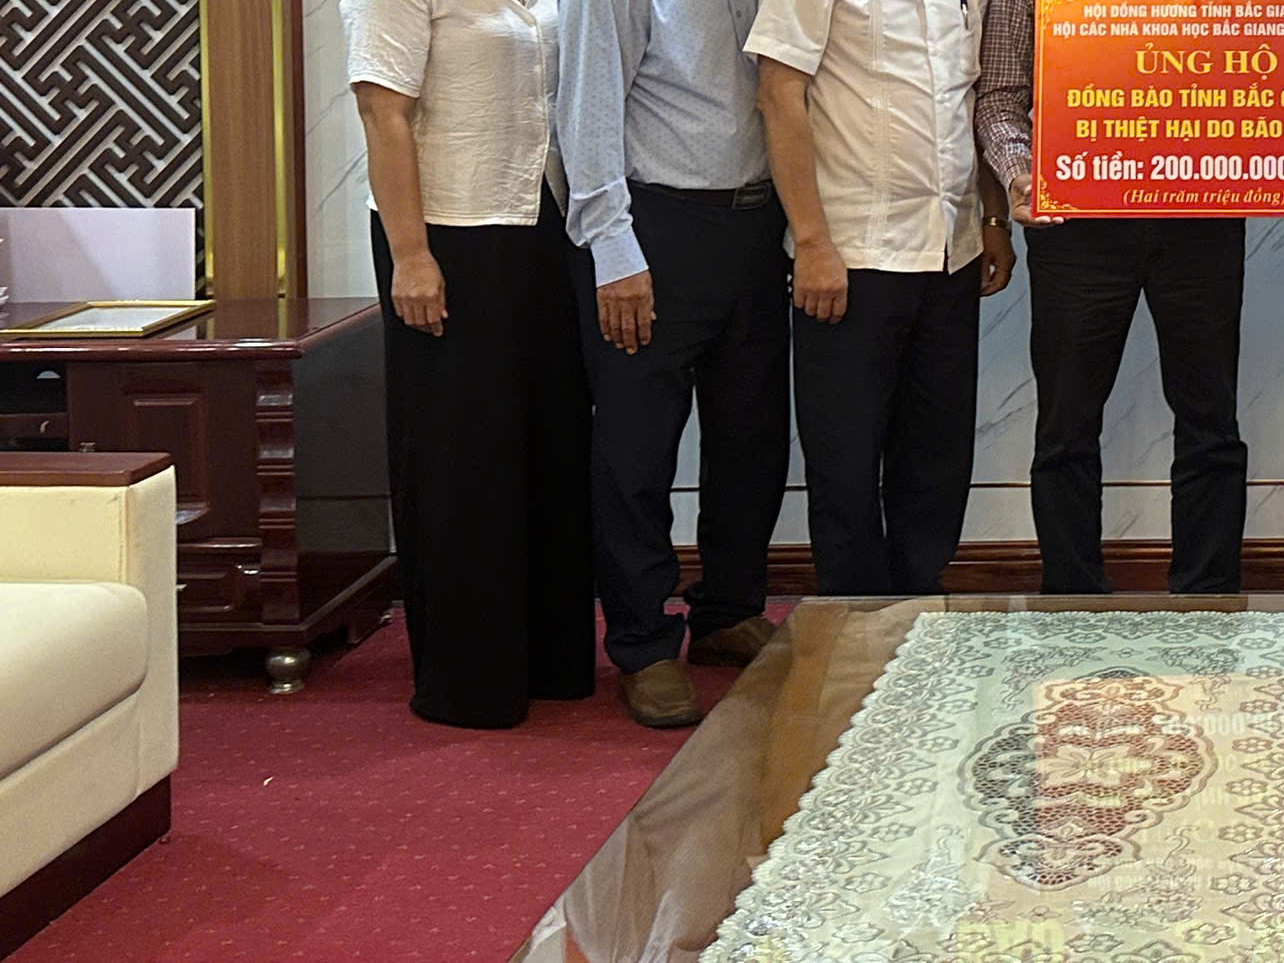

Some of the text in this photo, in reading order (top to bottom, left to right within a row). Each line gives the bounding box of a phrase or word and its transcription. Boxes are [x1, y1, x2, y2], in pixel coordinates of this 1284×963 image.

[1083, 3, 1107, 20] HỘI
[1053, 21, 1076, 39] HỘI
[1079, 21, 1107, 36] CÁC
[1110, 21, 1138, 36] NHÀ
[1142, 23, 1179, 36] KHOA
[1181, 23, 1209, 38] HỌC
[1244, 23, 1284, 36] GIANG
[1135, 42, 1278, 80] ỦNG HỘ
[1130, 85, 1173, 108] BÀO
[1179, 83, 1226, 108] TỈNH
[1233, 83, 1274, 108] BẮC
[1076, 119, 1097, 141] BỊ
[1103, 116, 1160, 142] THIỆT
[1166, 119, 1200, 142] HẠI
[1207, 120, 1235, 138] DO
[1241, 116, 1282, 138] BÃO
[1056, 151, 1088, 181] Số
[1093, 150, 1144, 181] tiền:
[1123, 188, 1159, 205] (Hai
[1162, 190, 1199, 203] trăm
[1203, 189, 1240, 205] triệu
